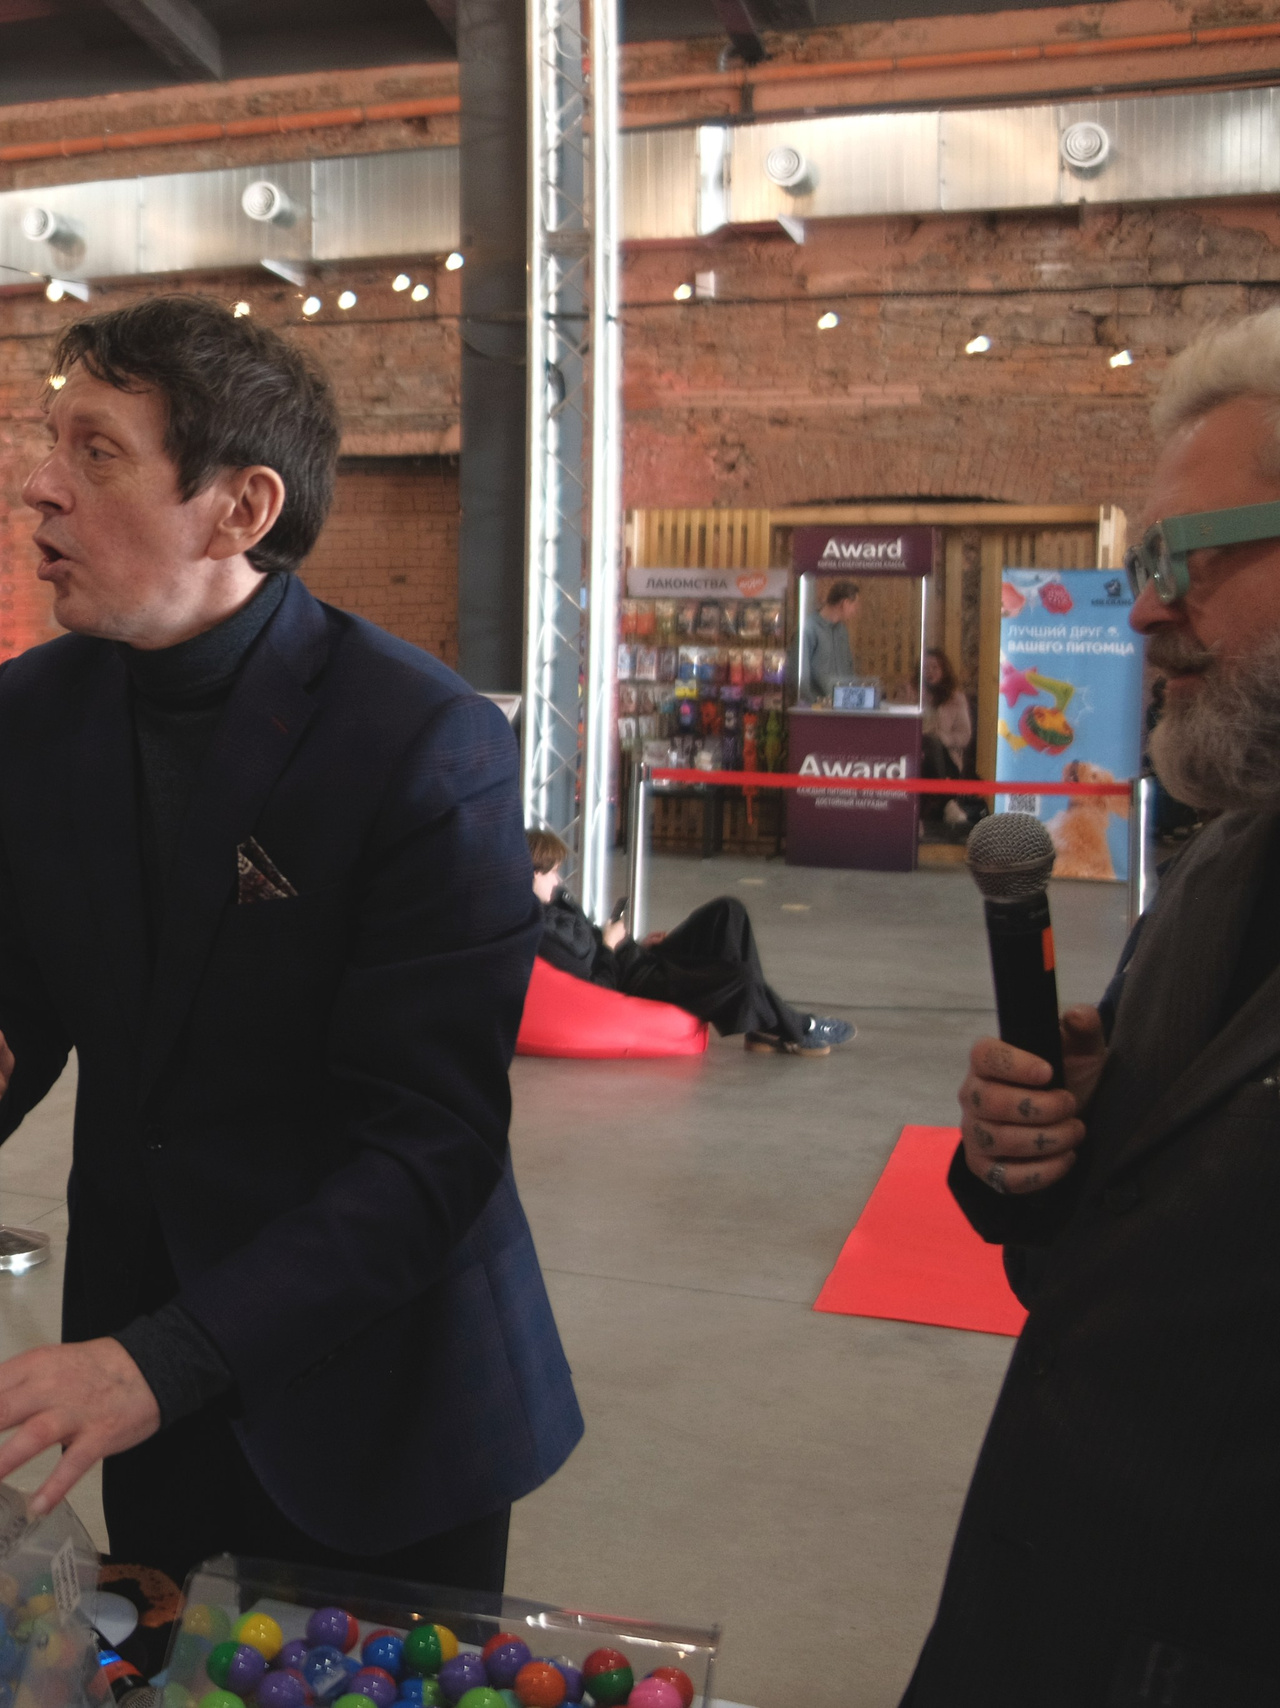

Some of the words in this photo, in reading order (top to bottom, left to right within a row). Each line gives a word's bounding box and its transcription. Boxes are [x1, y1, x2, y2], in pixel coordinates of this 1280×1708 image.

[822, 537, 902, 559] Award
[646, 577, 728, 590] ЛАКОМСТВА
[1008, 623, 1066, 638] ЛУЧШИЙ
[1069, 625, 1103, 640] ДРУГ
[1008, 640, 1063, 654] ВАШЕГО
[1066, 641, 1135, 657] ПИТОМЦА
[799, 753, 907, 780] Award
